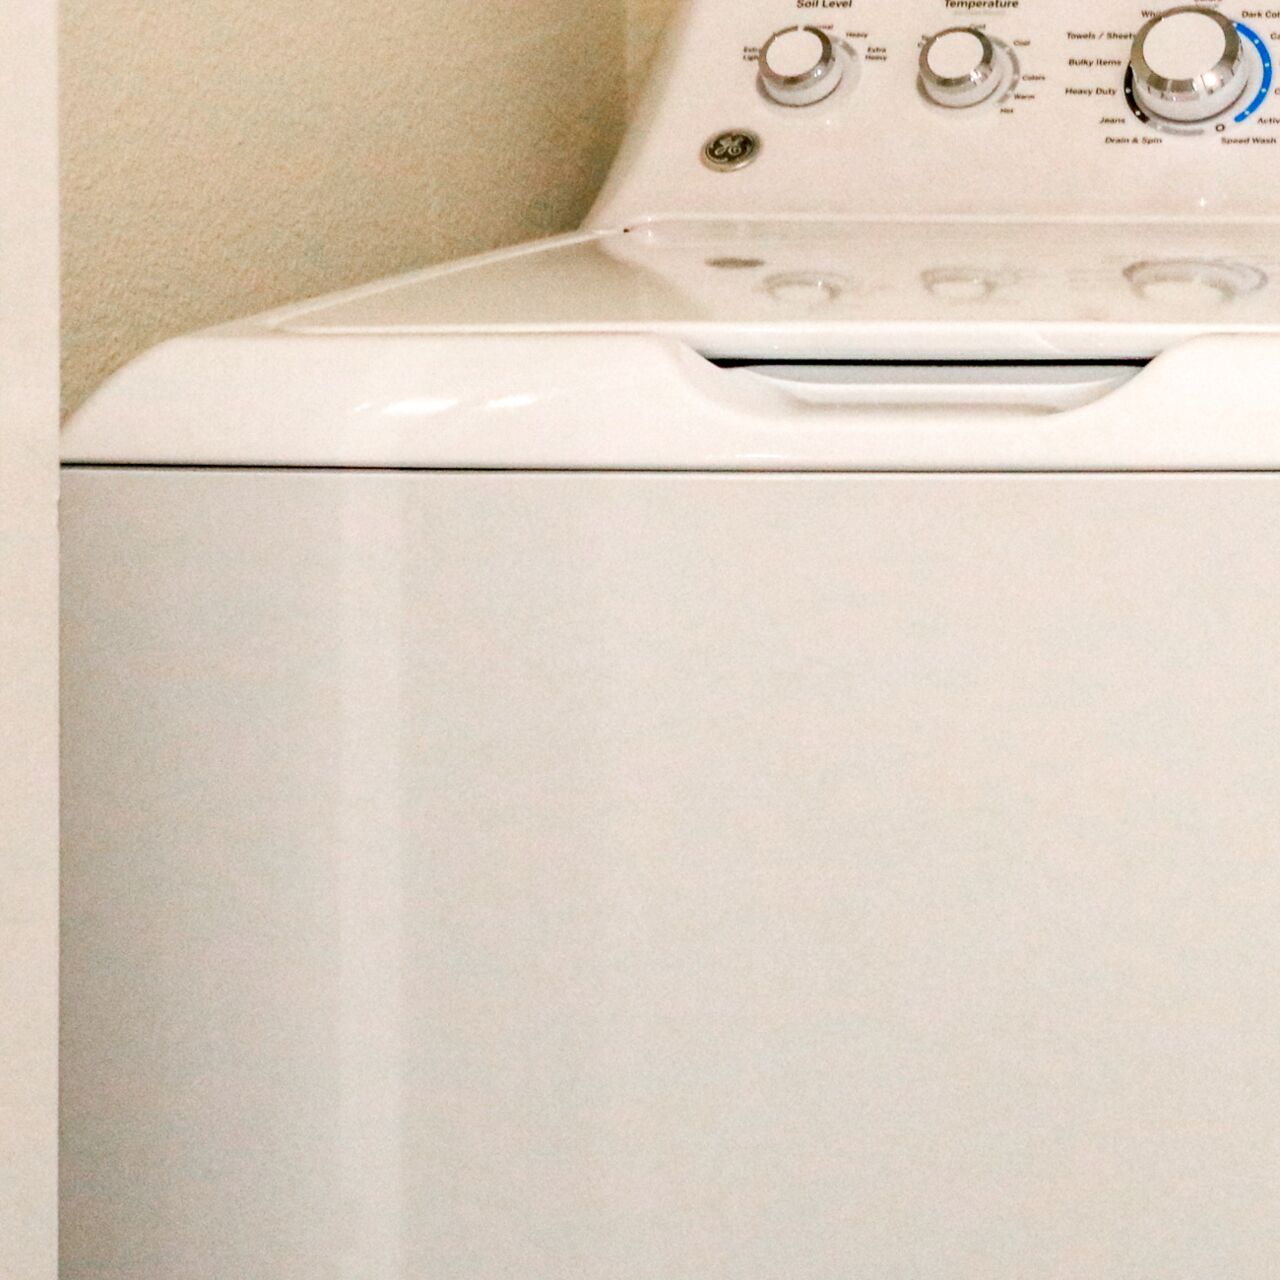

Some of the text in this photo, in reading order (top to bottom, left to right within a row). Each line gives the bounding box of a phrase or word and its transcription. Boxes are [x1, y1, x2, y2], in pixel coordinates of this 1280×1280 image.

[1241, 10, 1262, 18] Dark
[1067, 32, 1096, 40] Towels
[1068, 59, 1093, 67] Bulky
[1065, 88, 1117, 96] Heavy Duty
[1100, 117, 1126, 125] Jeans
[1141, 137, 1163, 145] Spin
[1221, 137, 1250, 145] Speed
